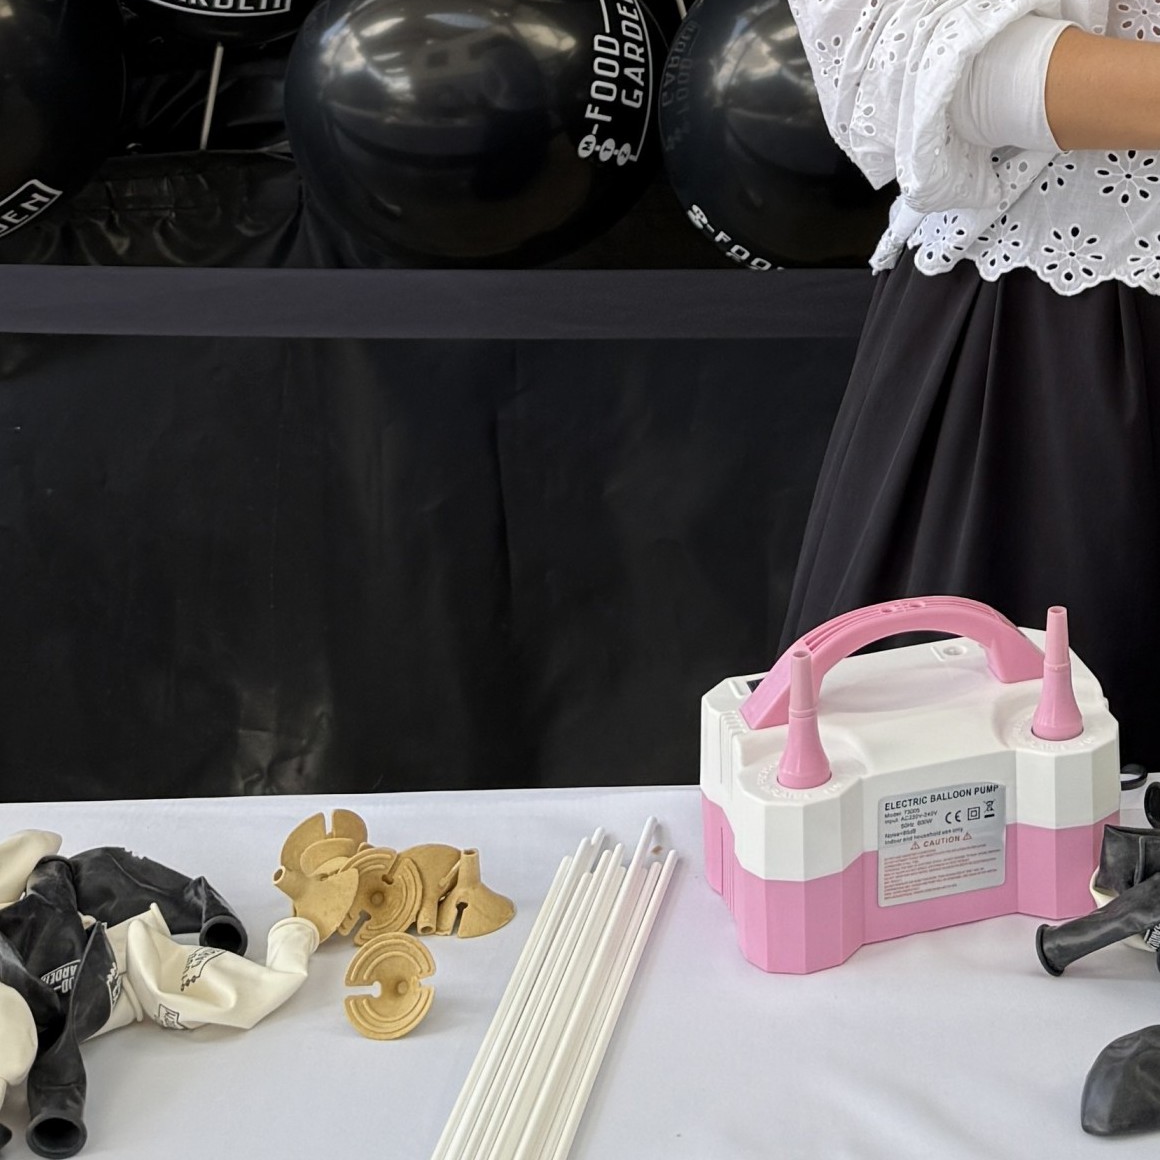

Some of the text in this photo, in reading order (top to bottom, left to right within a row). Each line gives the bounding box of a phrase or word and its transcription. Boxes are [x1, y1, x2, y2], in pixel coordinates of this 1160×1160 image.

[585, 33, 621, 123] FOOD
[714, 230, 785, 270] FOO
[884, 784, 999, 811] ELECTRIC BALLOON PUMP
[923, 836, 960, 848] CAUTION
